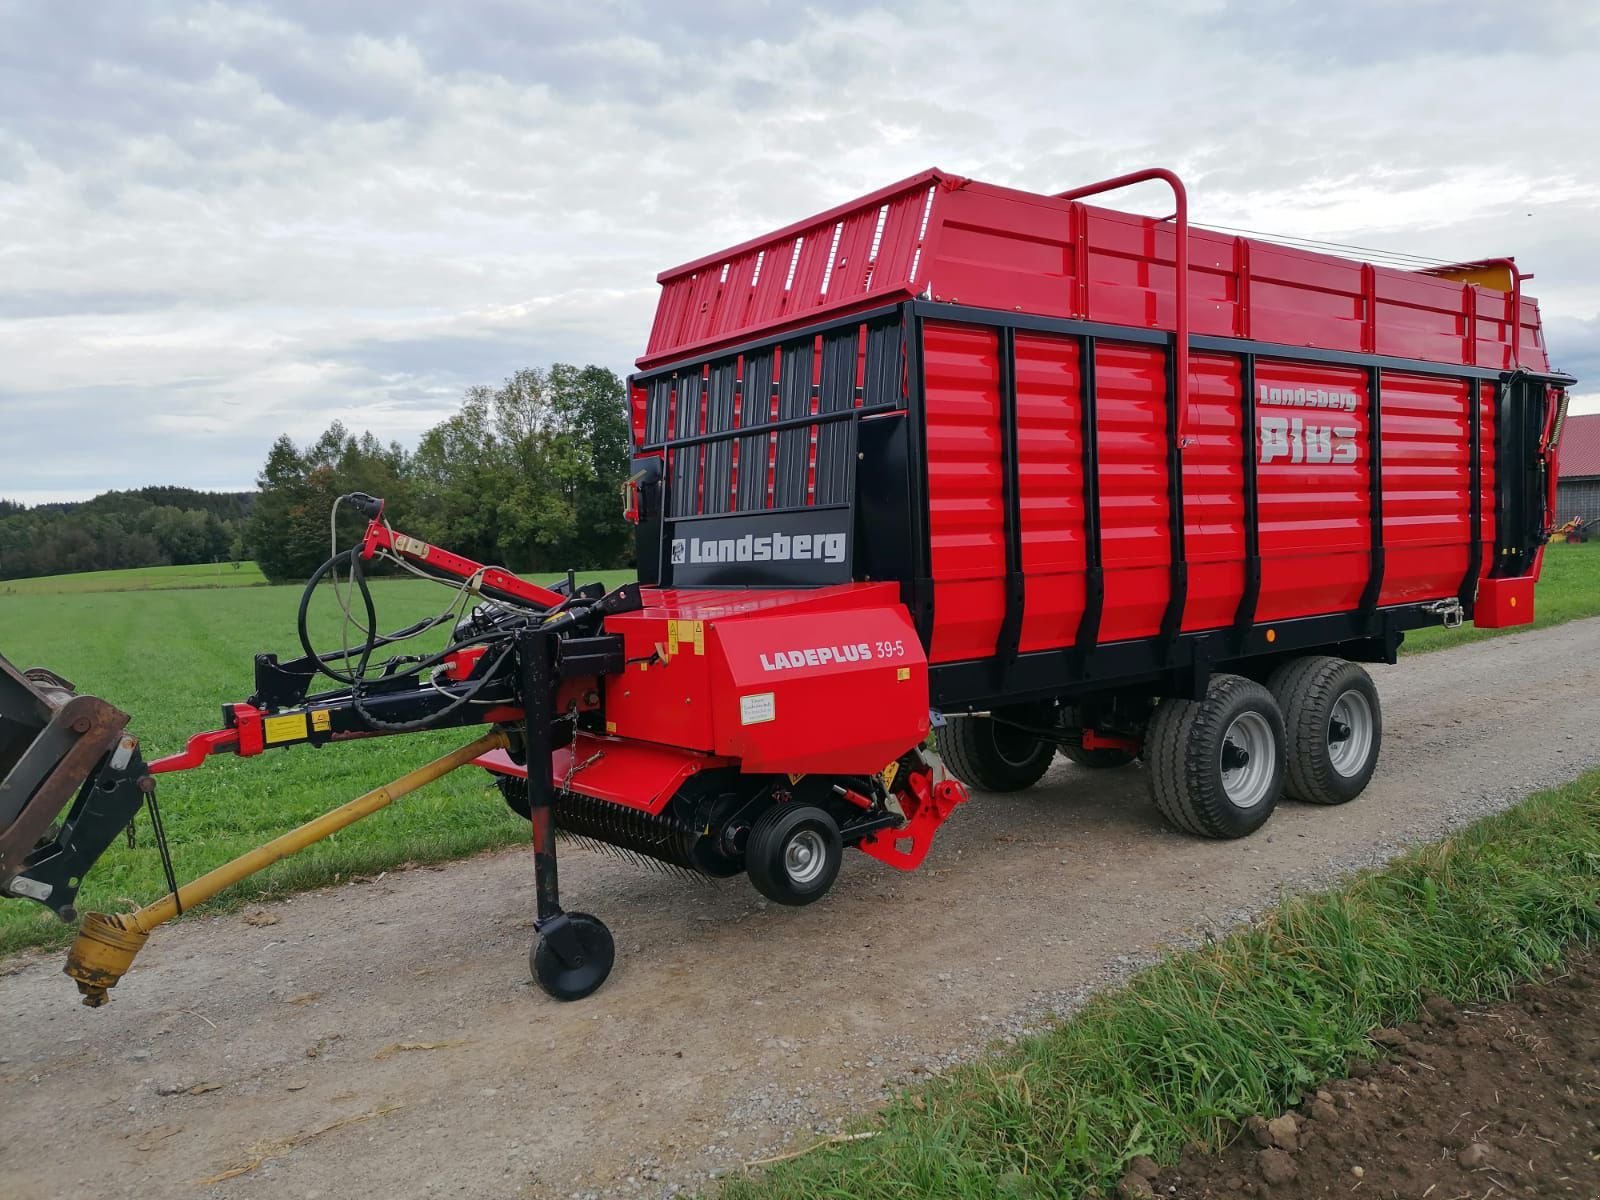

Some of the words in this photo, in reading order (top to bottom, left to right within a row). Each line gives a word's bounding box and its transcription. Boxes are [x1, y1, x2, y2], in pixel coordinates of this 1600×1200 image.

[1260, 385, 1357, 412] Landsberg
[1260, 416, 1357, 463] Plus
[690, 532, 846, 563] Landsberg
[760, 643, 872, 671] LADEPLUS
[875, 640, 904, 658] 39-5
